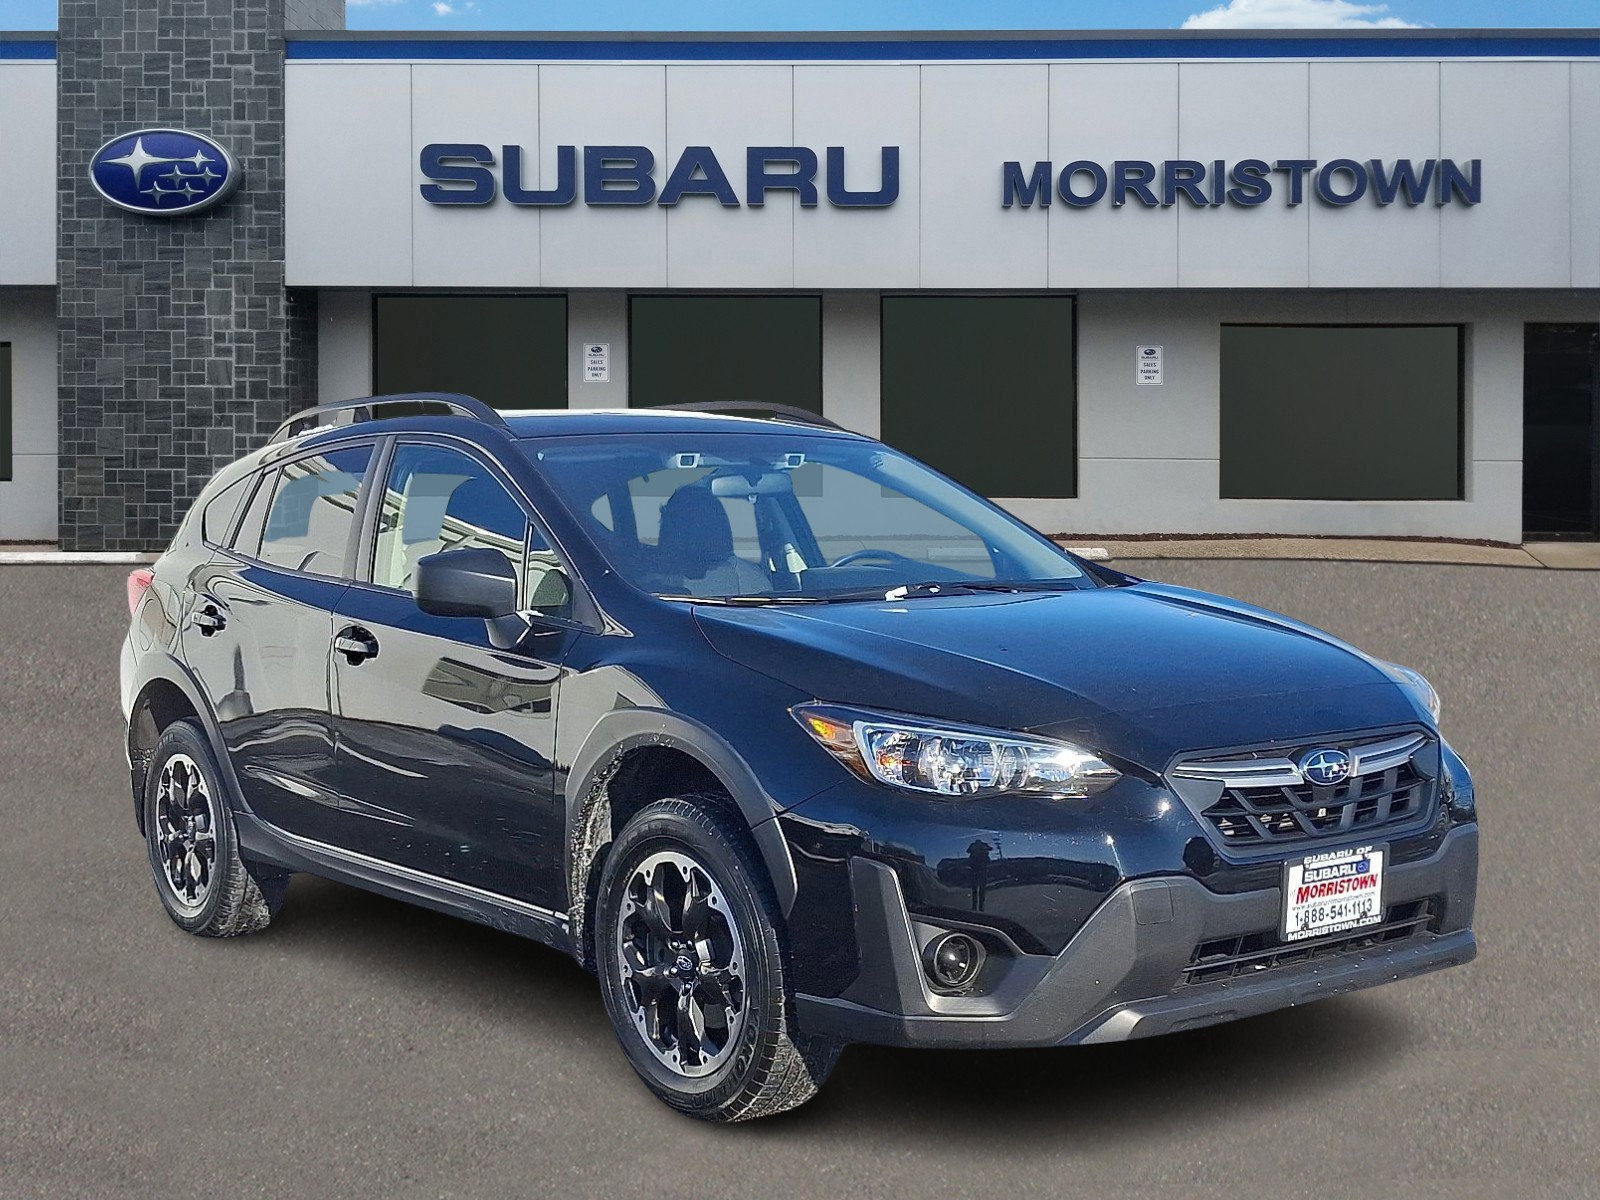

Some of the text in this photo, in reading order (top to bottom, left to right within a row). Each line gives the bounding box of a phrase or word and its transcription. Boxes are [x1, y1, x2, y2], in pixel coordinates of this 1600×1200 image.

[419, 143, 900, 207] SUBARU
[1001, 158, 1482, 208] MORRISTOWN
[1304, 845, 1373, 864] SUBARU OF
[1304, 863, 1357, 882] SUBARU
[1296, 873, 1378, 905] MORRISTOWN
[1288, 915, 1381, 941] MORRISTOWN.COM
